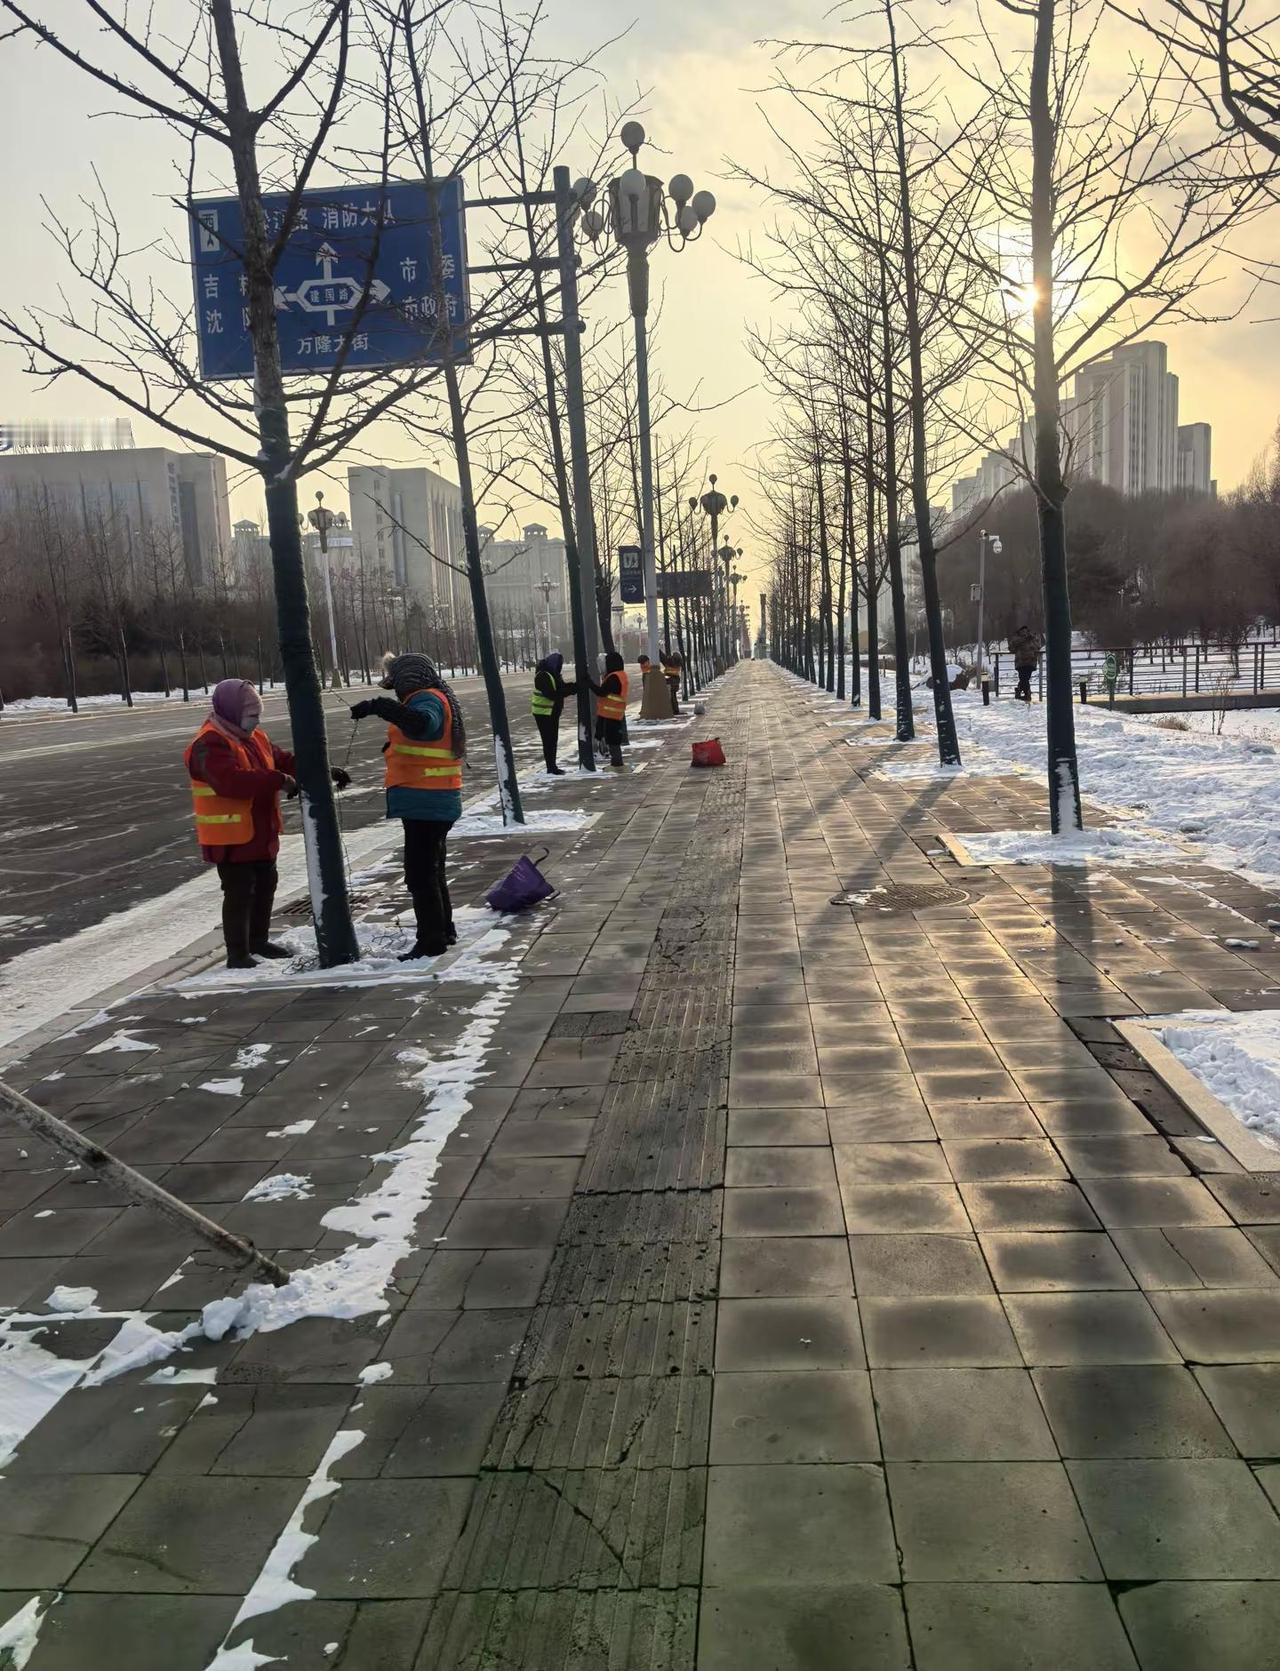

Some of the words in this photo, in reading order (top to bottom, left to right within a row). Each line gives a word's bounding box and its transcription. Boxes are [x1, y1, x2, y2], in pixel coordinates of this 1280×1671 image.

[322, 199, 397, 229] 消防大队
[206, 307, 250, 334] 沈
[297, 332, 369, 355] 万隆大街
